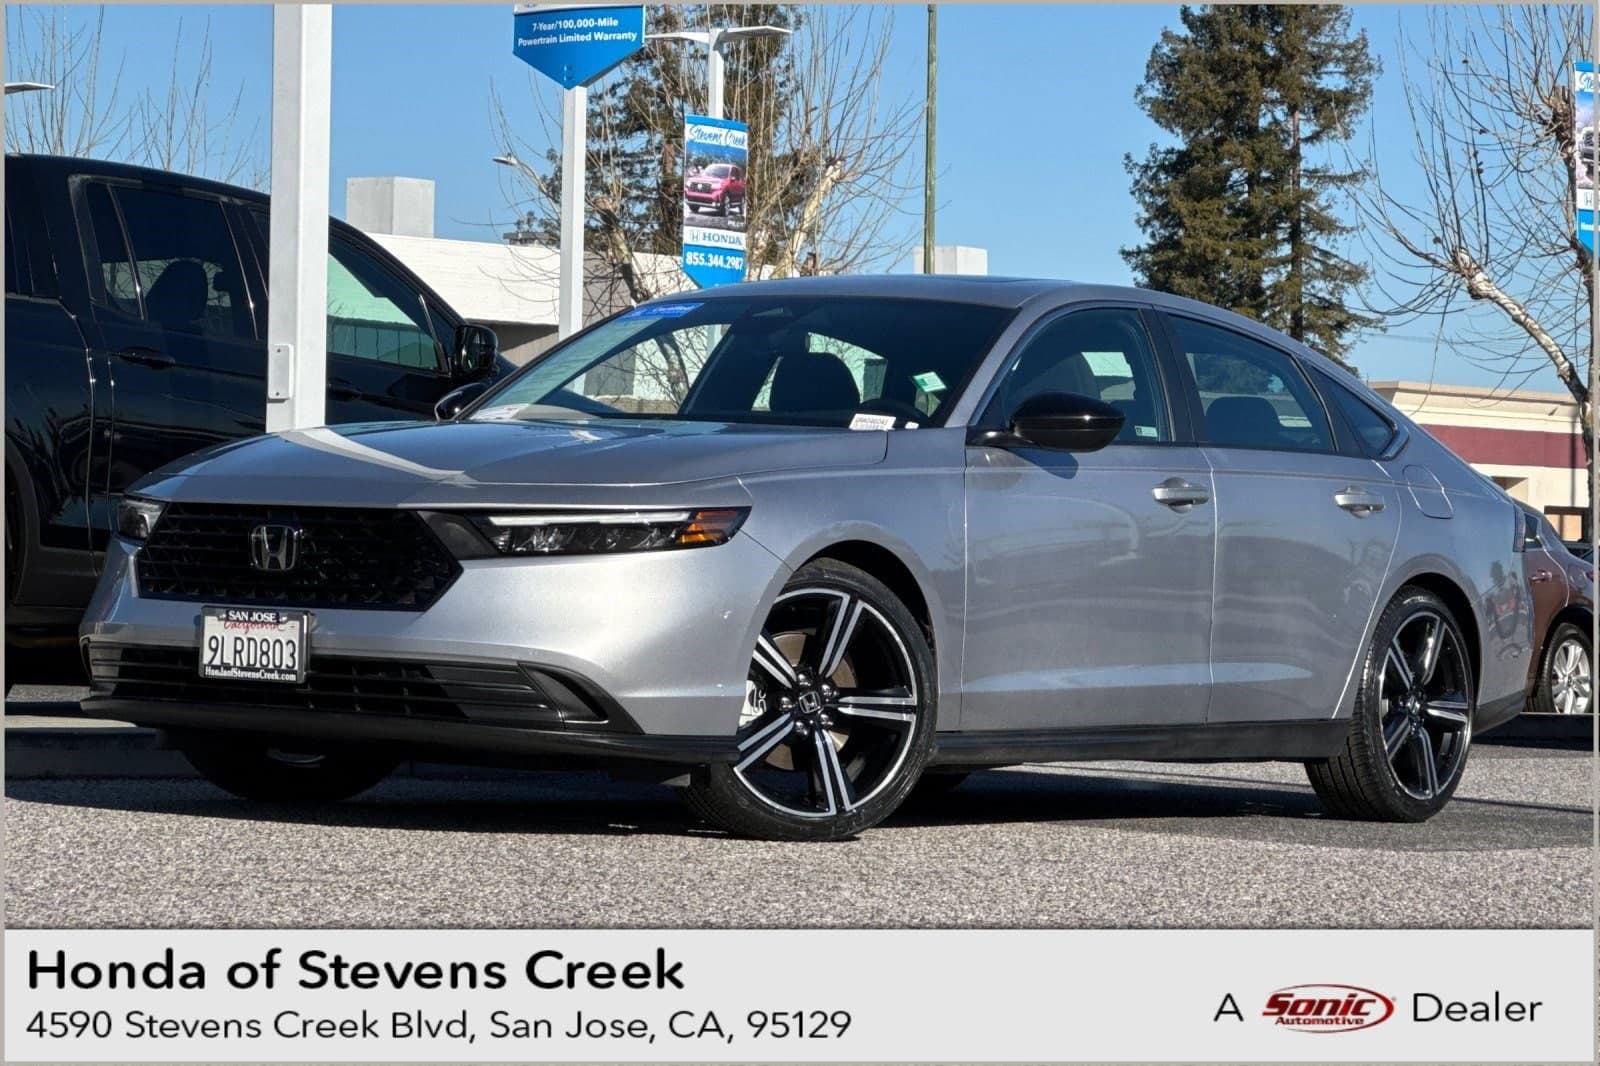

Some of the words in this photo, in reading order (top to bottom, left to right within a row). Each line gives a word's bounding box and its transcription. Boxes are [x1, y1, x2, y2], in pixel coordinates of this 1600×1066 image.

[532, 17, 619, 31] 7-Year/100,000-Mile
[518, 35, 557, 46] Powertrain
[559, 32, 591, 43] Limited
[594, 31, 637, 42] Warranty
[703, 232, 743, 245] HONDA
[686, 251, 744, 271] 855.344.2987
[228, 610, 249, 621] SAN
[250, 612, 276, 622] JOSE
[208, 635, 296, 669] 9LRD803
